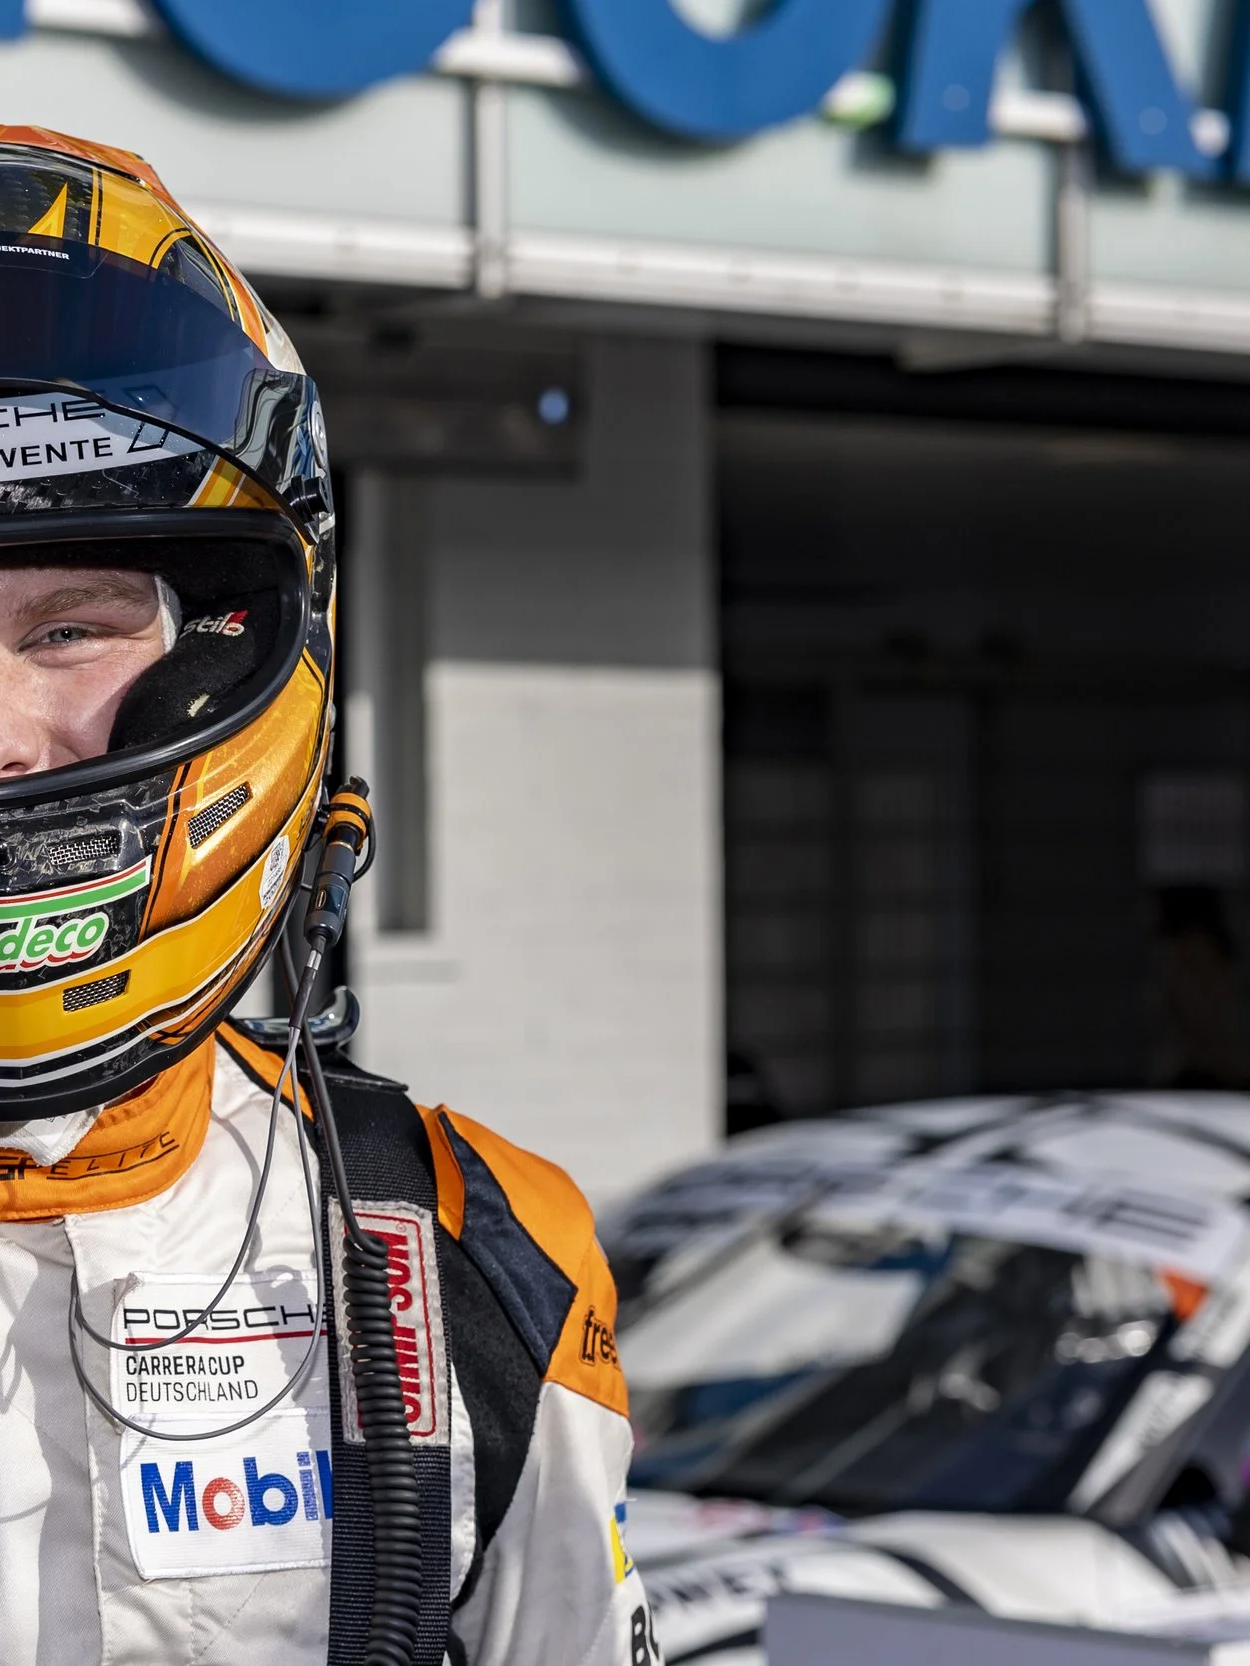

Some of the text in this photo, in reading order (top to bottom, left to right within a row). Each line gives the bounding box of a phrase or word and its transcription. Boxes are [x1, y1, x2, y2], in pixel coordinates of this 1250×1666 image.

[178, 610, 250, 640] stilo
[126, 1379, 259, 1402] DEUTSCHLAND
[140, 1449, 334, 1533] Mobil
